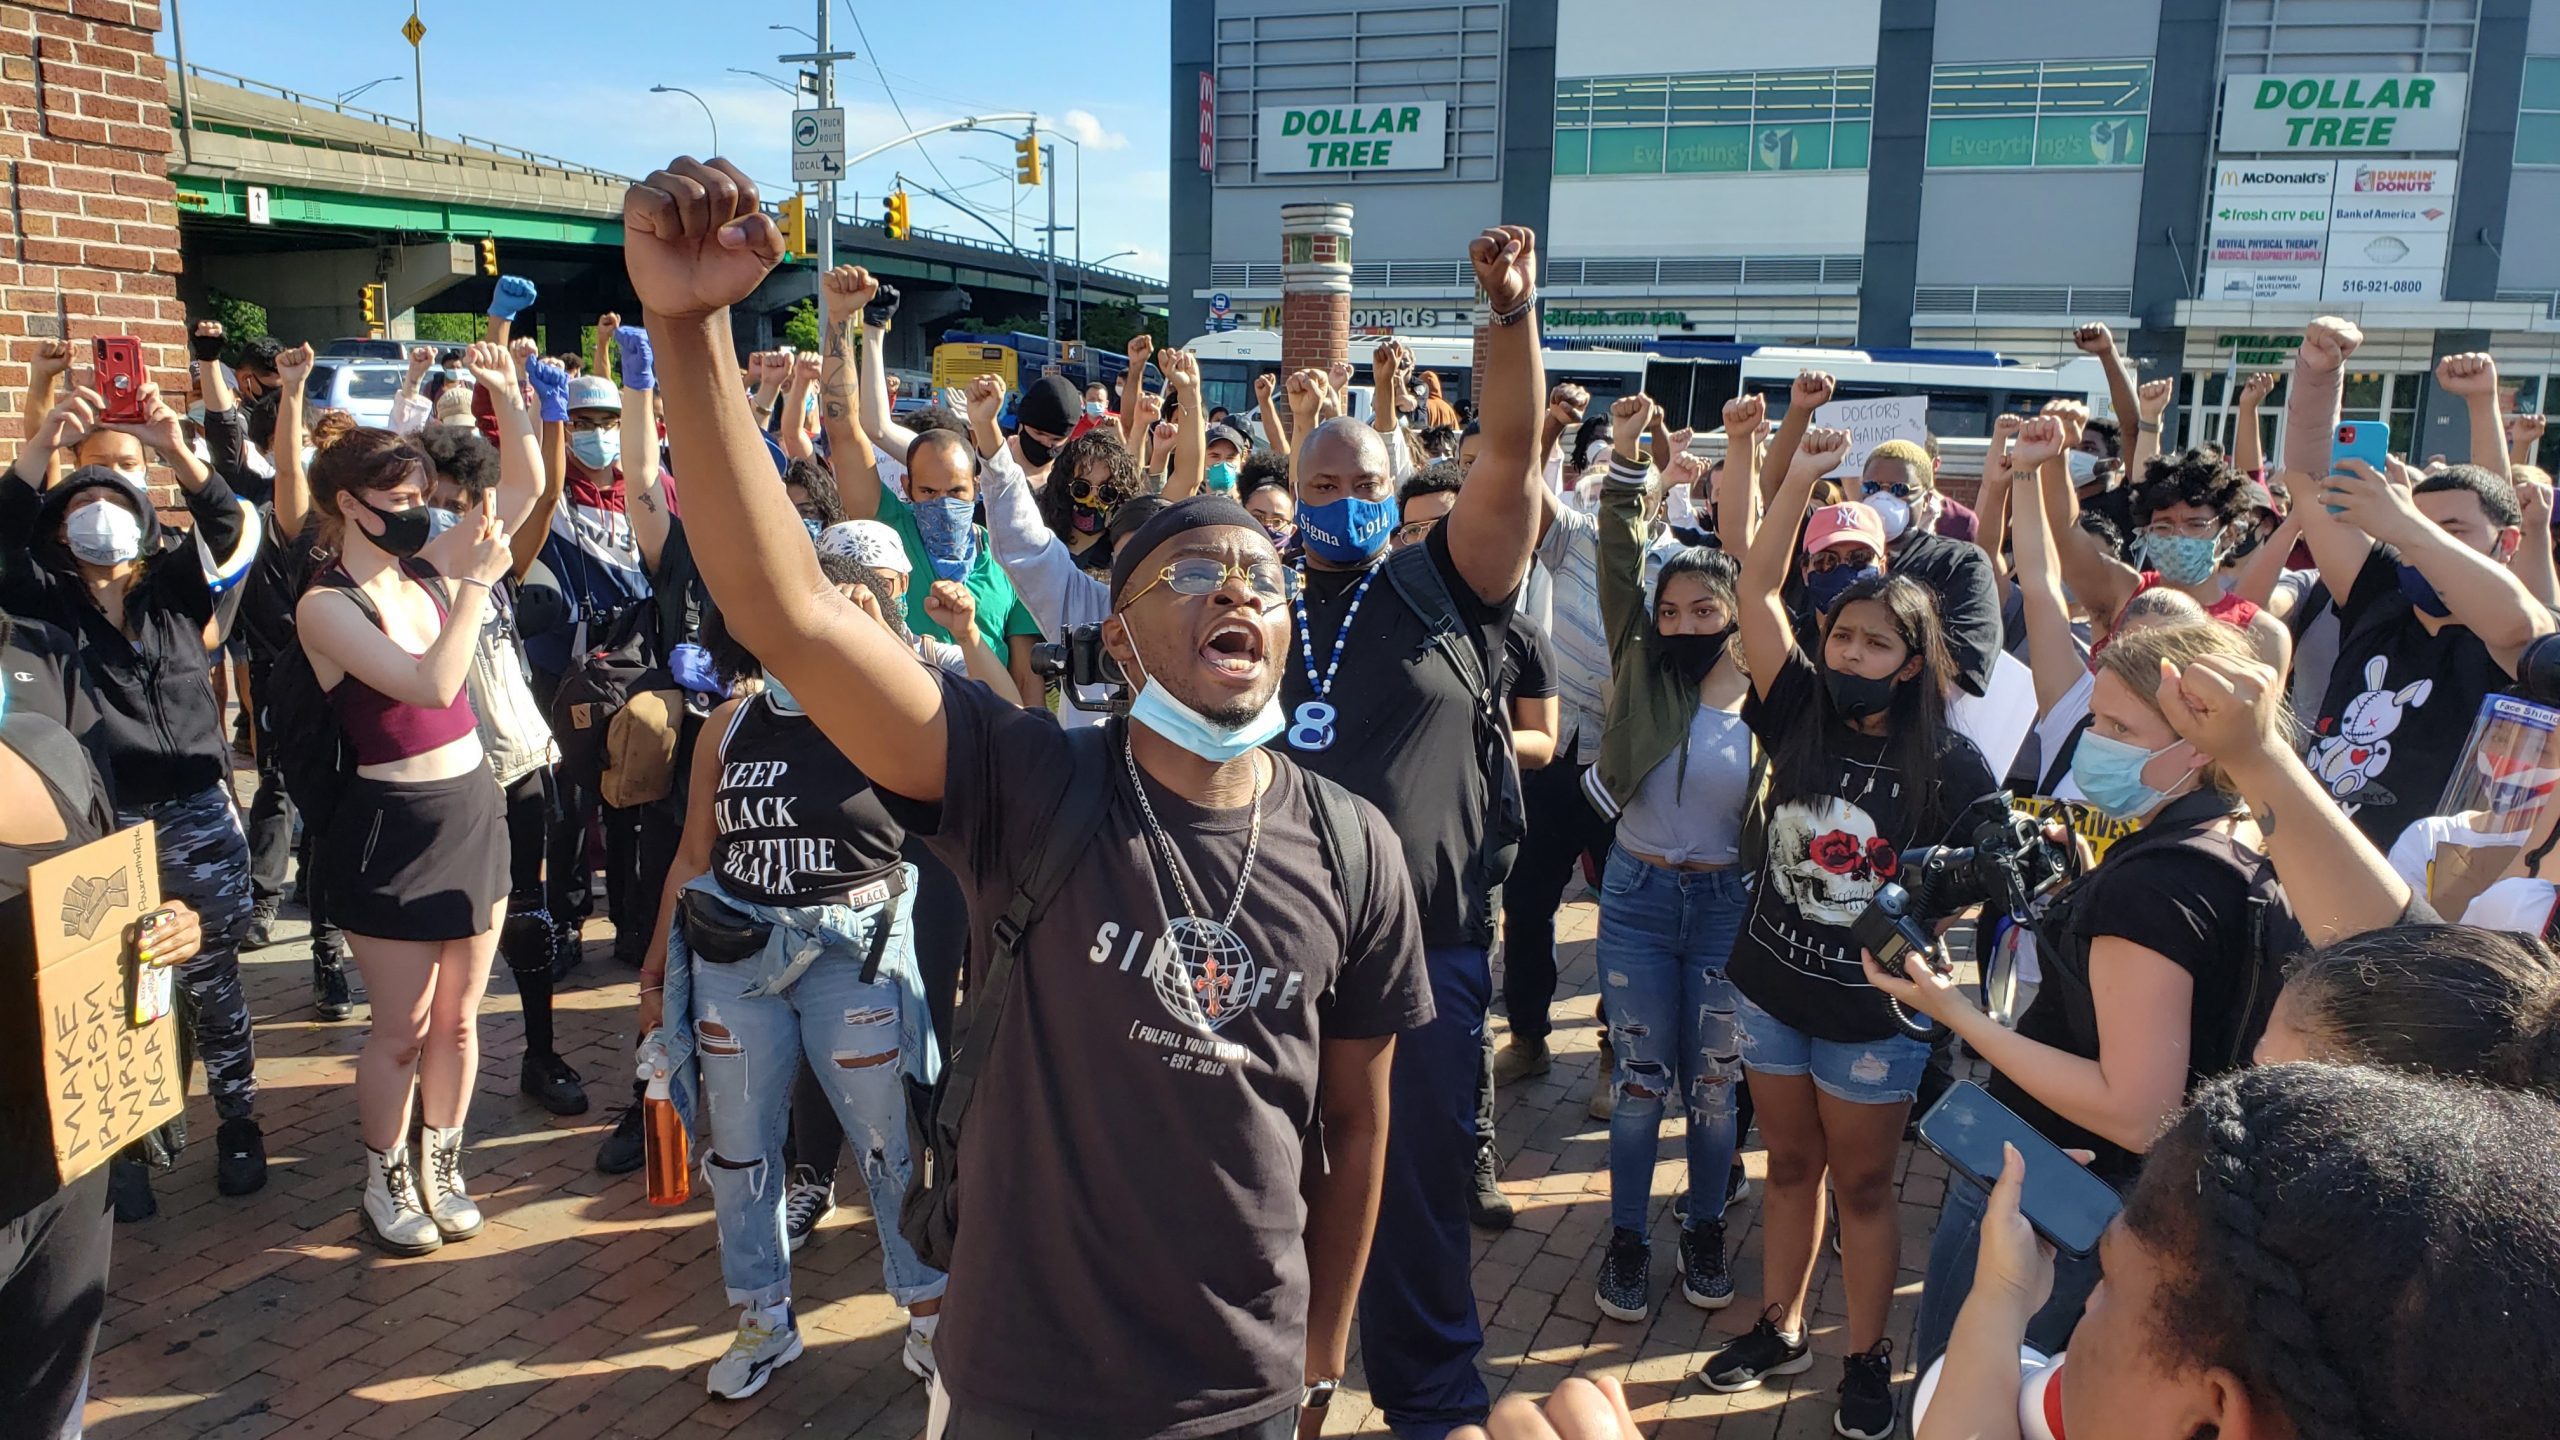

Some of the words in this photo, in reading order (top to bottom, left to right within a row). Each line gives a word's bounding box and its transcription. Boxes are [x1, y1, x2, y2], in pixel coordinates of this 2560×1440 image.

[2254, 79, 2436, 110] DOLLAR
[820, 118, 840, 128] TRUCK
[1282, 107, 1420, 136] DOLLAR
[2286, 117, 2397, 146] TREE
[820, 133, 840, 143] ROUTE
[1950, 135, 2083, 160] Everythng's
[1307, 140, 1392, 167] TREE
[795, 161, 820, 171] LOCAL
[2242, 172, 2327, 184] McDonald's
[2376, 182, 2432, 192] DONUTS
[2232, 208, 2268, 221] fresh
[2271, 210, 2296, 220] CITY
[2300, 210, 2325, 221] DELI
[2336, 209, 2361, 219] Bank
[2363, 209, 2373, 219] of
[2374, 209, 2416, 219] America
[2217, 239, 2245, 249] REVIVAL
[2248, 239, 2283, 249] PHYSICAL
[2286, 239, 2318, 249] THERAPY
[2218, 250, 2248, 260] MEDICAL
[2251, 250, 2292, 260] EQUIPMENT
[2342, 280, 2422, 292] 516-921-0800
[1351, 307, 1436, 328] onald's
[1842, 403, 1900, 422] DOCTORS
[1300, 513, 1340, 547] Sigma
[1357, 511, 1390, 543] 1914
[2500, 701, 2521, 712] Face
[1288, 701, 1336, 750] 8
[716, 761, 788, 793] KEEP
[714, 796, 798, 835] BLACK
[853, 887, 887, 907] BLACK
[1184, 1036, 1213, 1055] YOUR
[108, 983, 144, 1136] WRONG
[1169, 1053, 1194, 1071] EST.
[1195, 1058, 1227, 1076] 2016
[54, 1001, 91, 1160] MAKE
